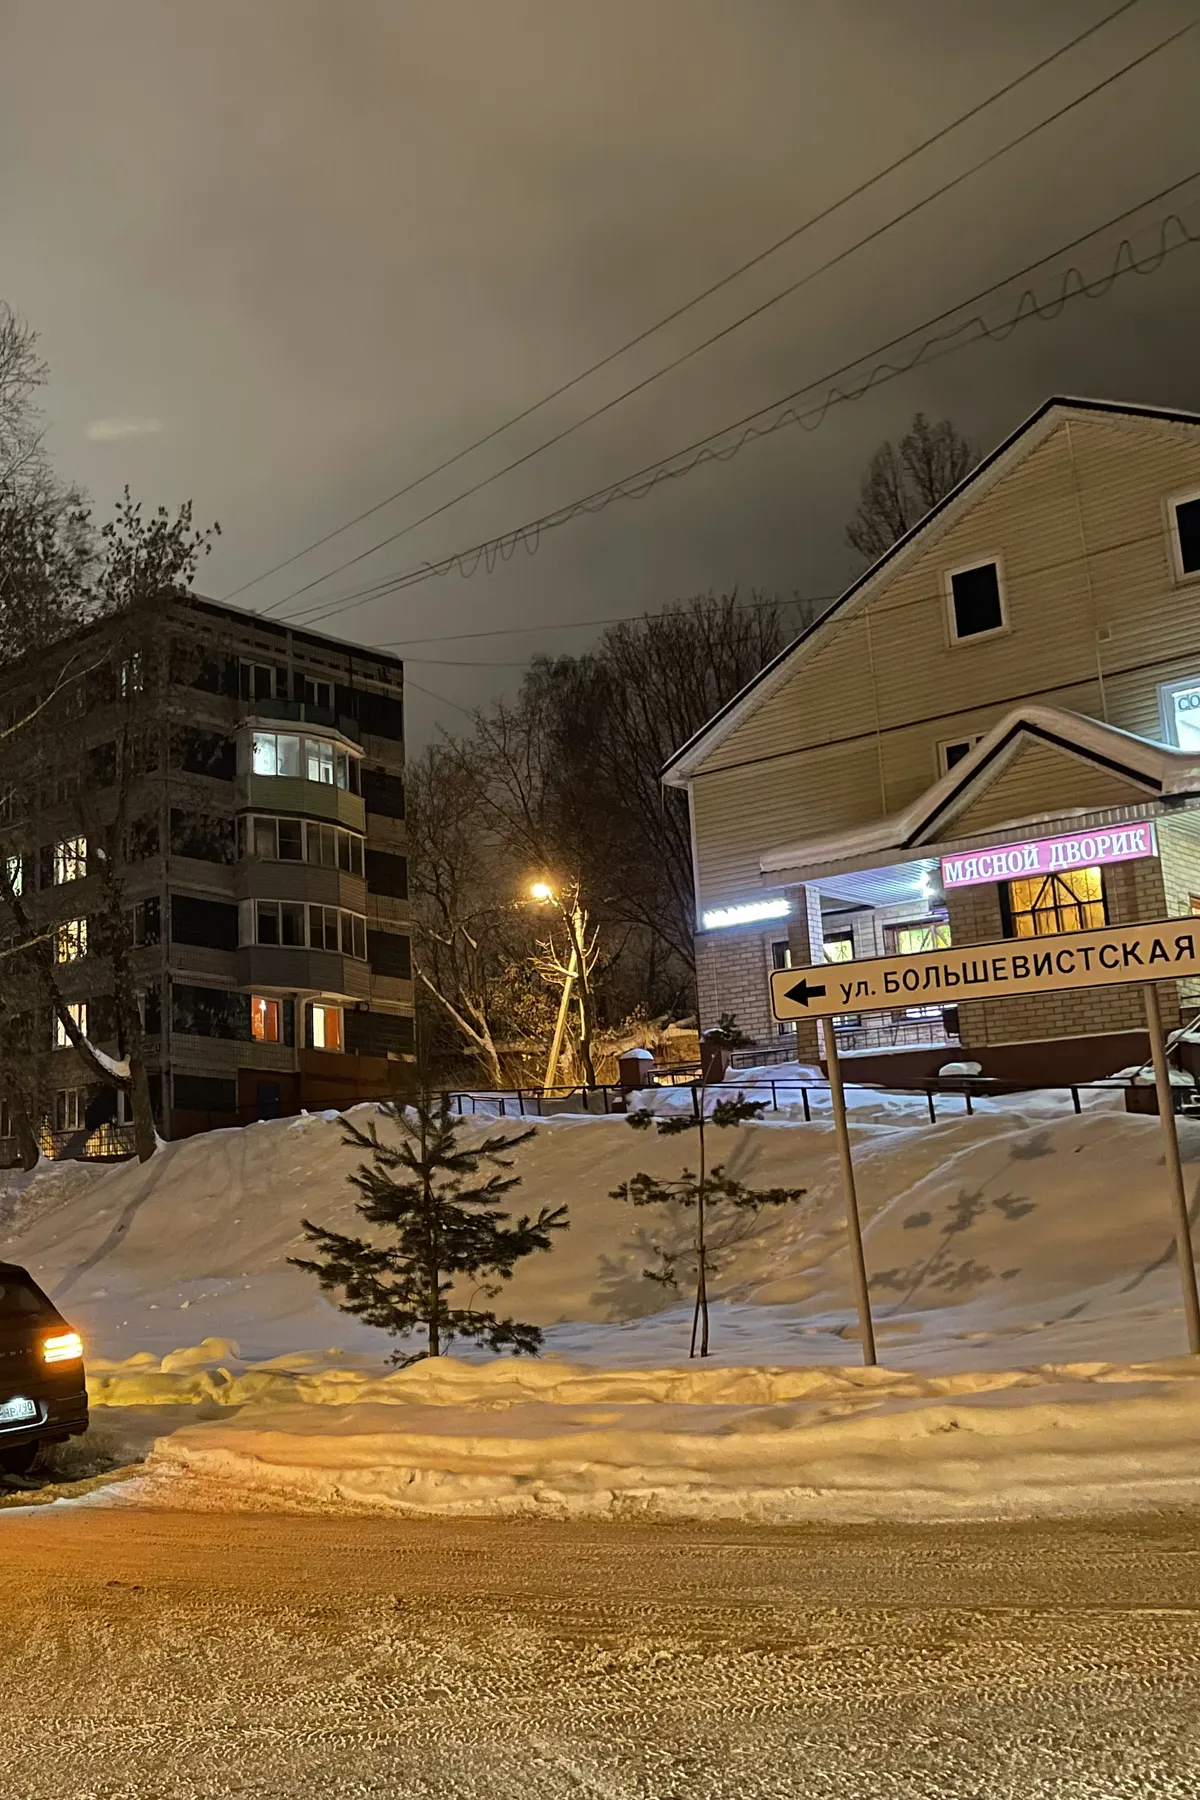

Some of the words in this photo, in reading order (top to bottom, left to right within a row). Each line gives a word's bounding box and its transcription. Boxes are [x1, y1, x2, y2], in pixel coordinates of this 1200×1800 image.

[943, 844, 1040, 884] МЯСНОЙ
[1049, 828, 1146, 870] ДВОРИК
[839, 980, 876, 1005] ул.
[883, 935, 1195, 994] БОЛЬШЕВИСТСКАЯ
